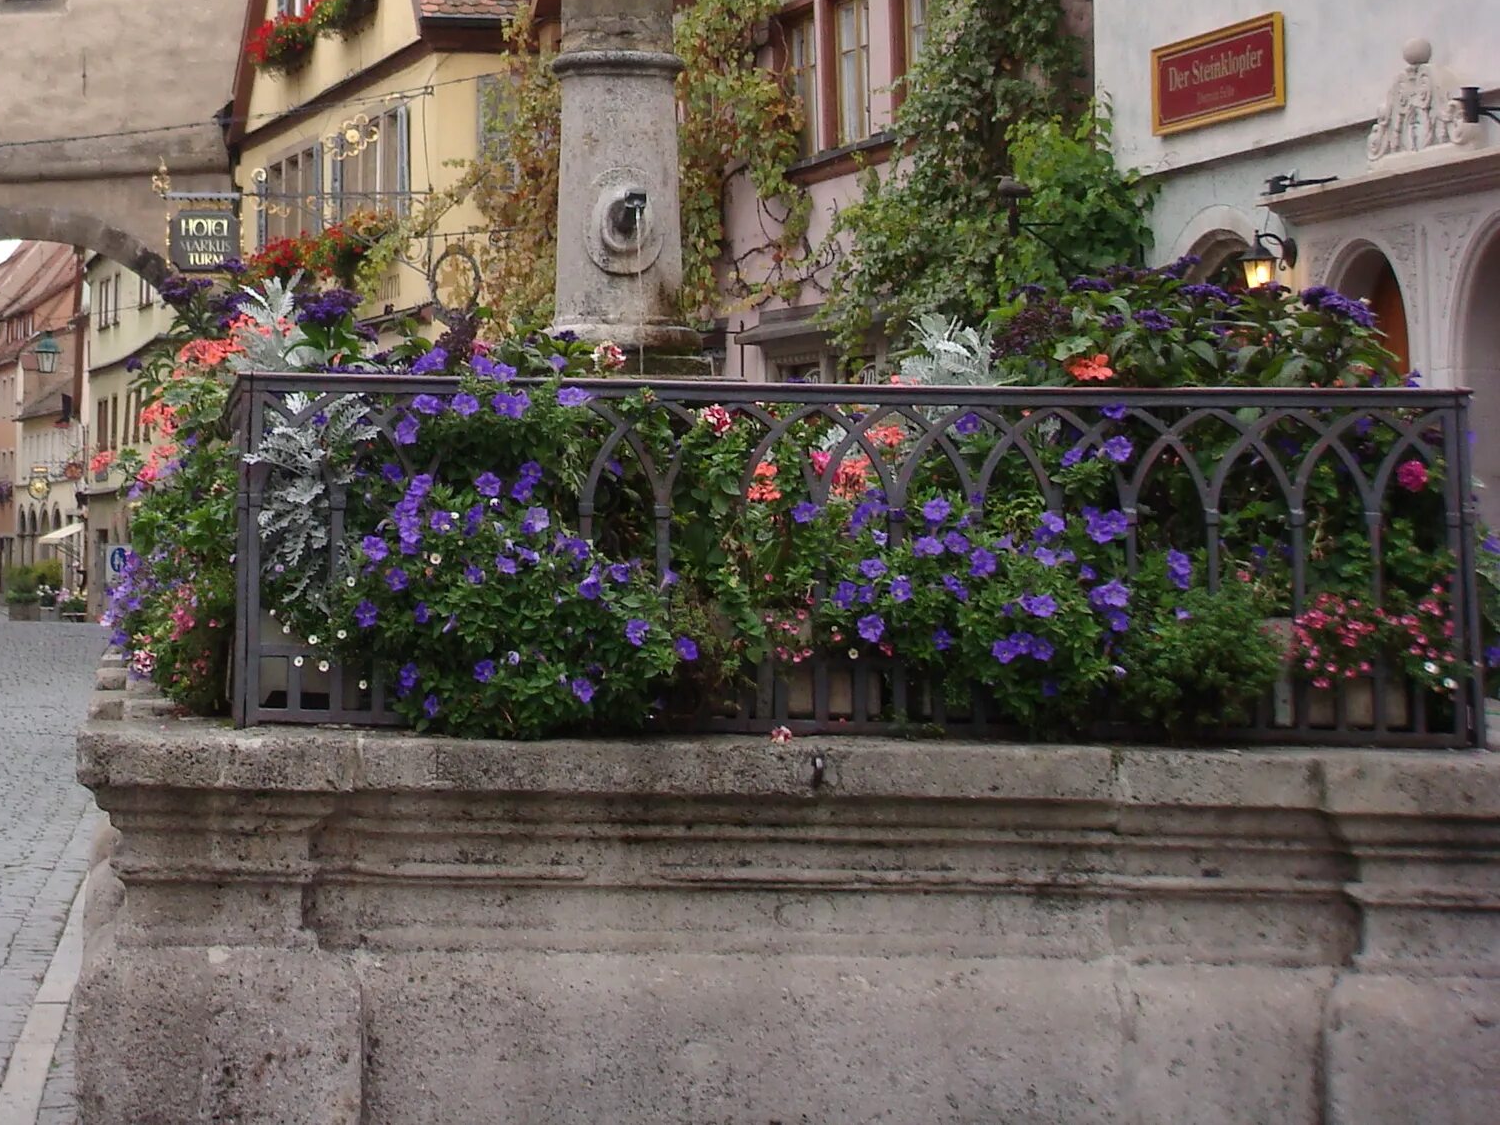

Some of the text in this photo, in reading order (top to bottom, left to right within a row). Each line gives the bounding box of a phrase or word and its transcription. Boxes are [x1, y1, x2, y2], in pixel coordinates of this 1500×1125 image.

[1169, 44, 1264, 91] Der Steinklopfer
[181, 218, 228, 236] HOTEL
[180, 239, 232, 253] MARKUS
[187, 252, 225, 266] TURM
